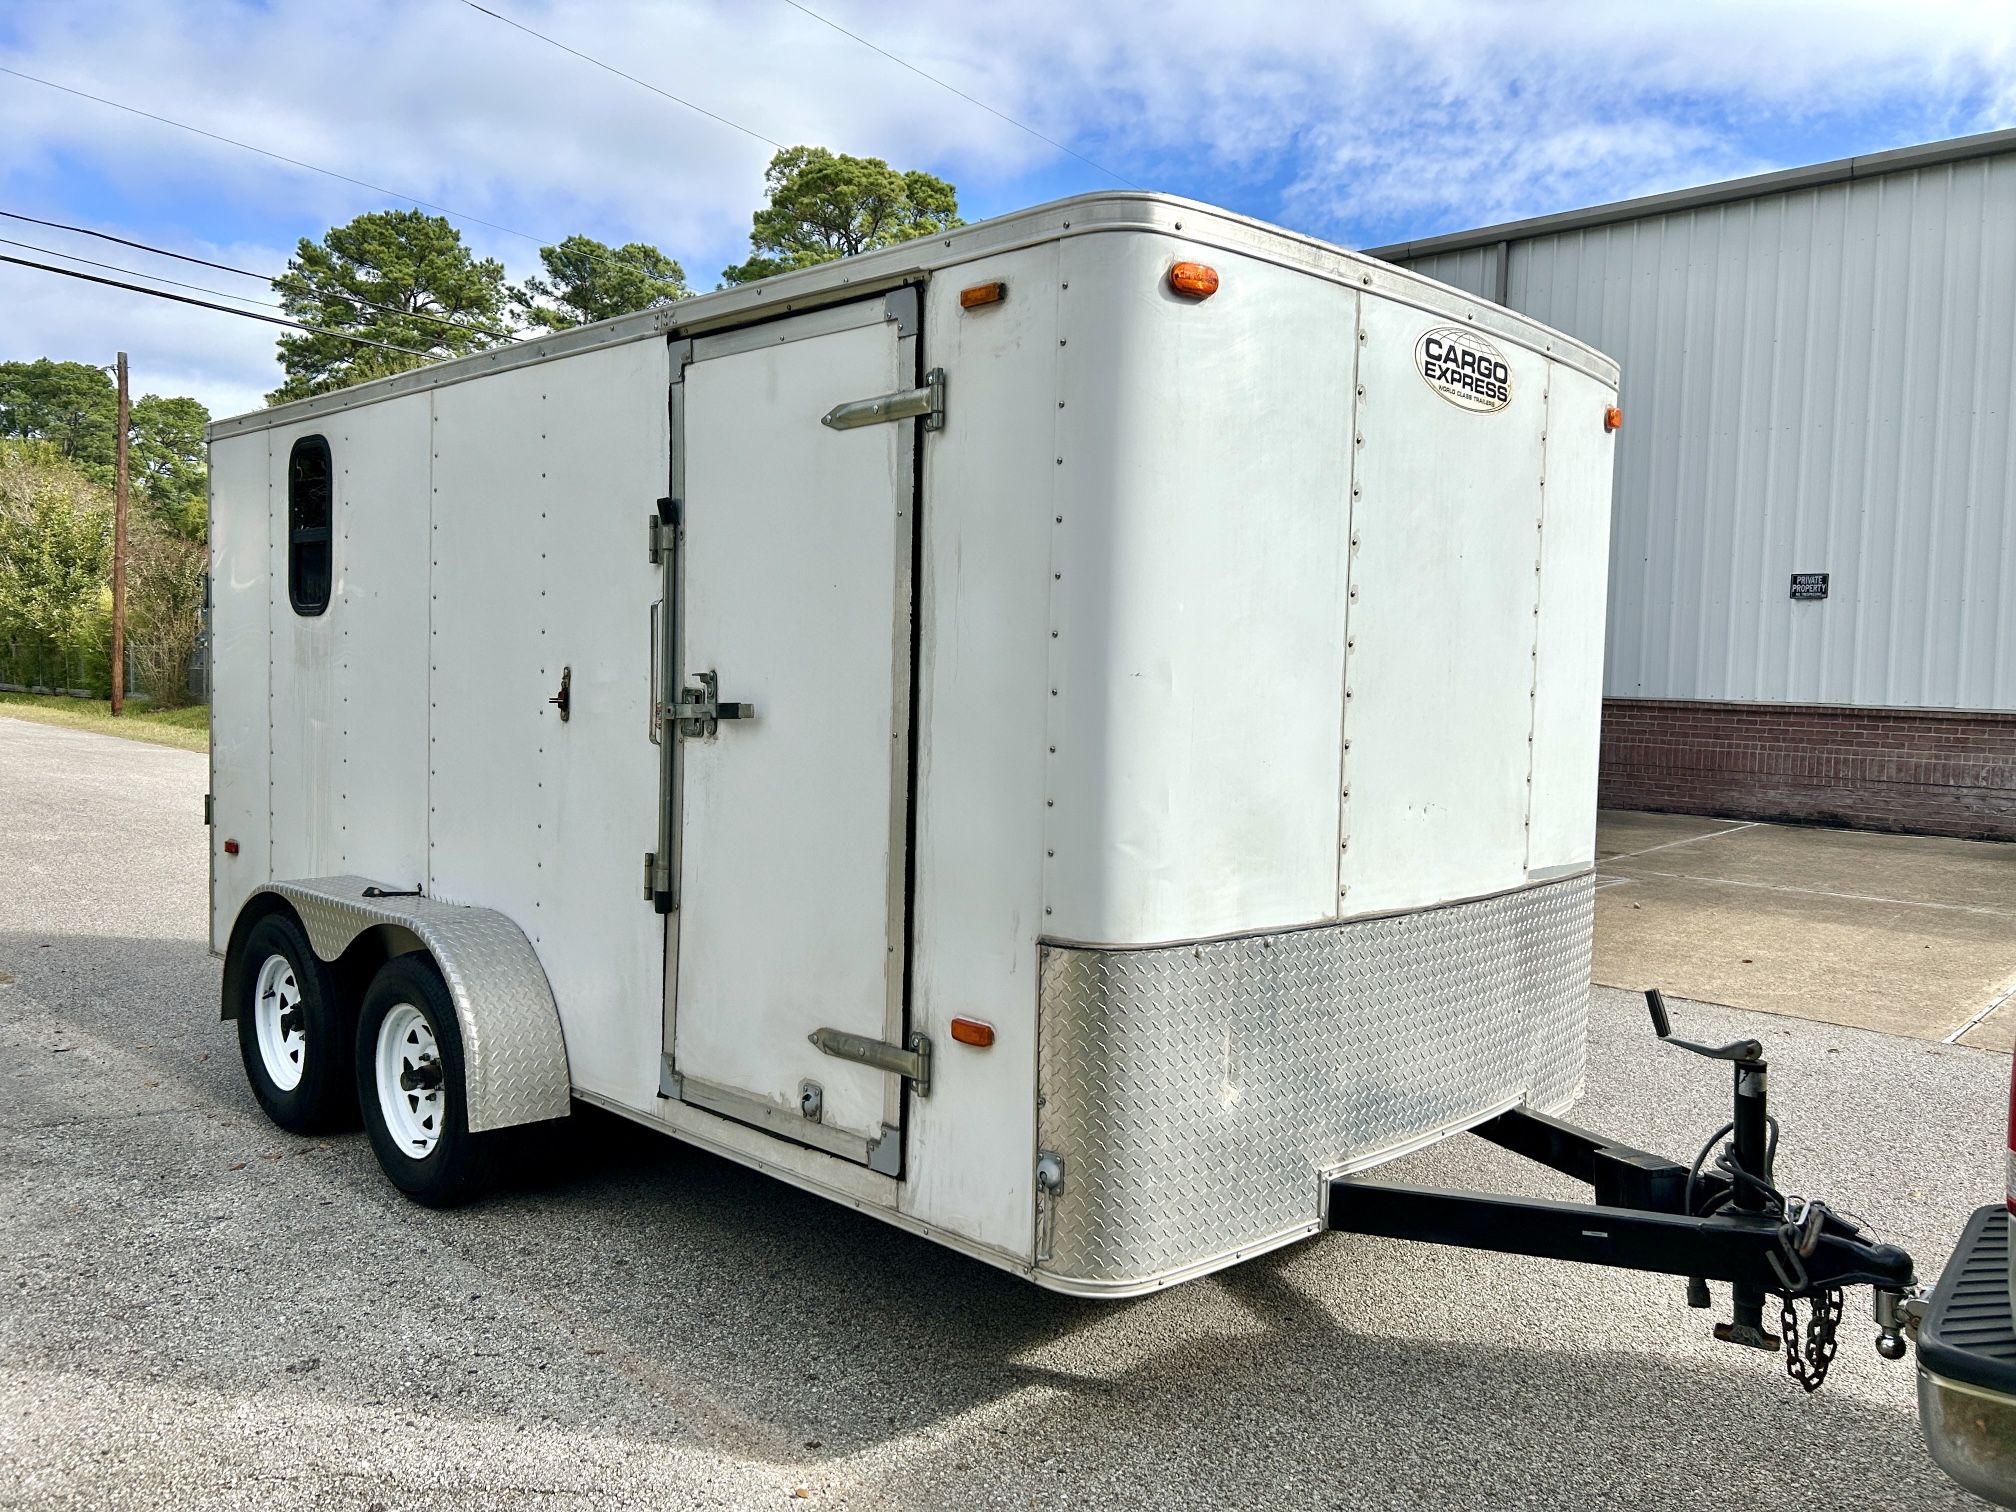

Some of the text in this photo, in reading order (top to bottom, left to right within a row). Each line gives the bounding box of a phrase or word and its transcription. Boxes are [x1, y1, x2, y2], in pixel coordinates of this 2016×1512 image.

[1425, 337, 1508, 384] CARGO
[1425, 360, 1508, 402] EXPRESS
[1438, 384, 1495, 407] WORLD CLASS TRAILERS
[1792, 584, 1826, 592] PROPERTY
[1796, 576, 1823, 584] PRIVATE
